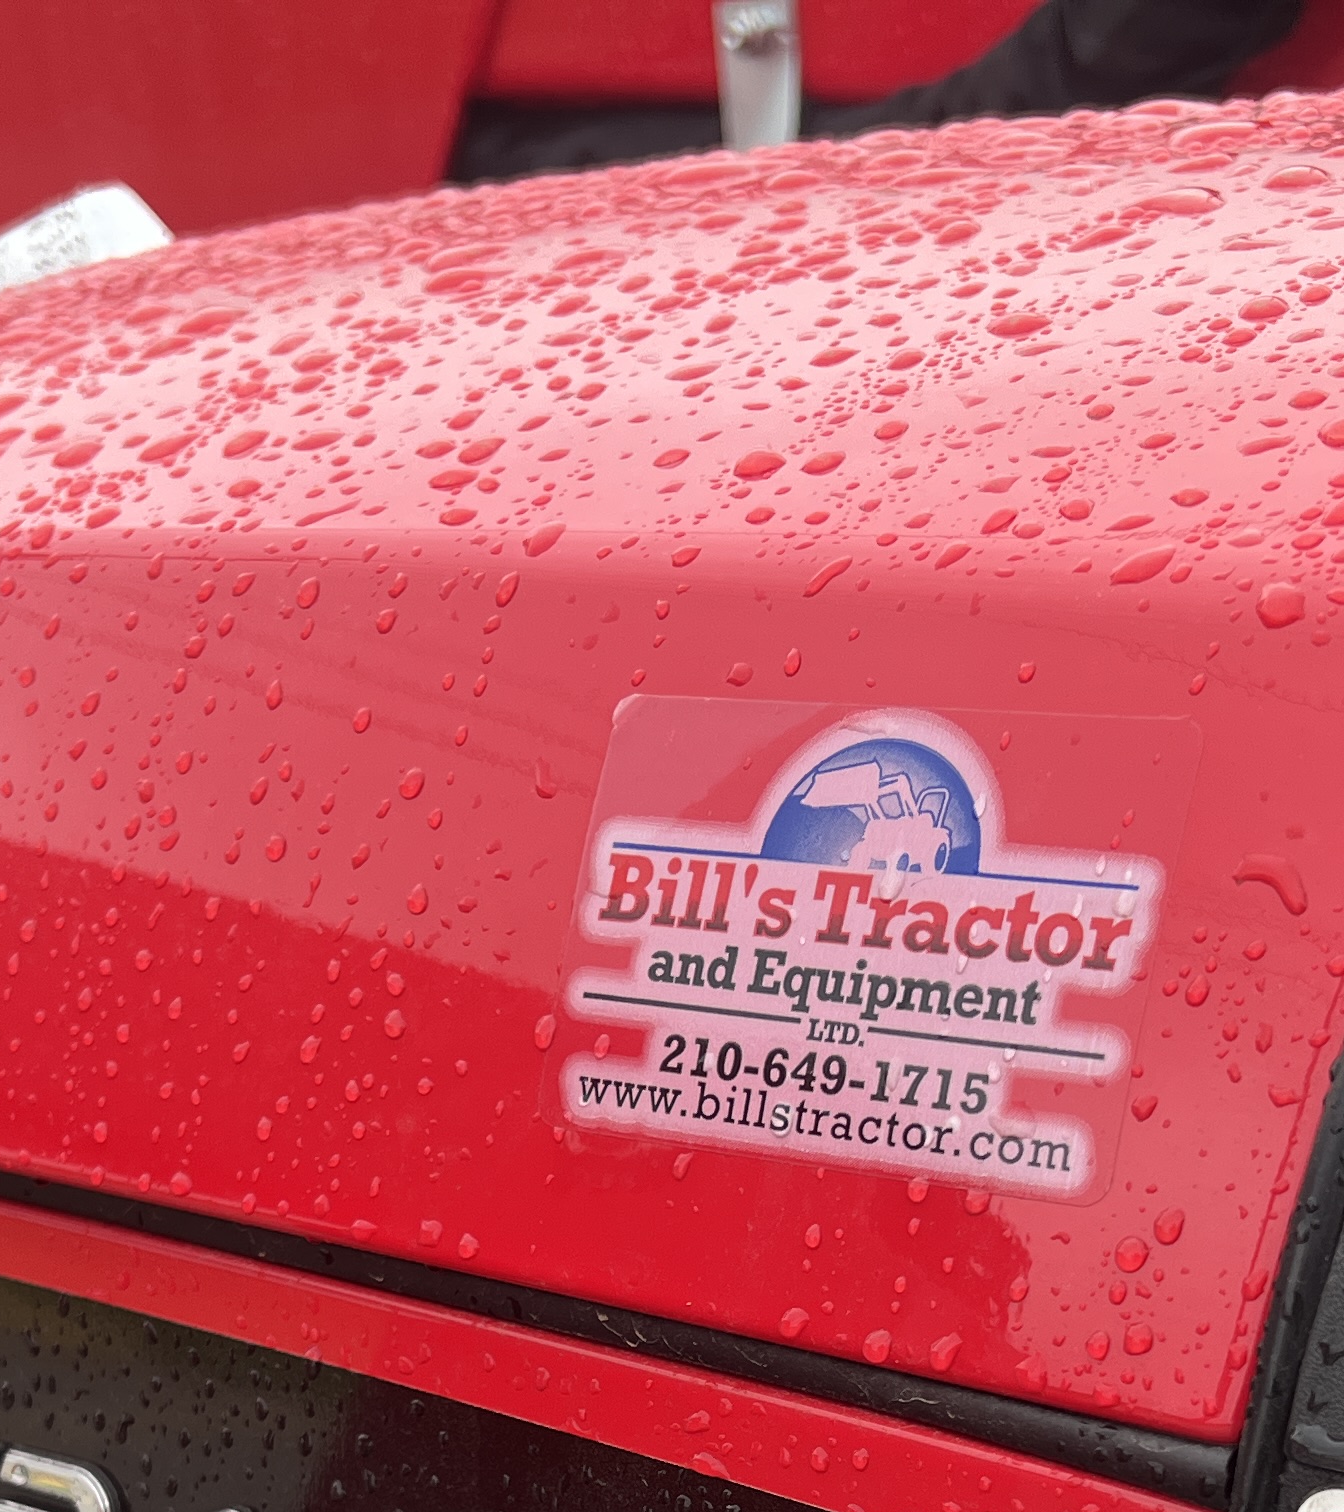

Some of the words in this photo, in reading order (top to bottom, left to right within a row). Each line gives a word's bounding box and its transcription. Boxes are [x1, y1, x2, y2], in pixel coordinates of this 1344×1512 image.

[599, 852, 797, 938] Bill's
[812, 871, 1134, 971] Tractor
[648, 947, 736, 991] and
[748, 949, 1042, 1025] Equipment
[806, 1019, 865, 1047] LTD.
[659, 1035, 991, 1114] 210-649-1715
[578, 1075, 1071, 1171] www.billstractor.com
